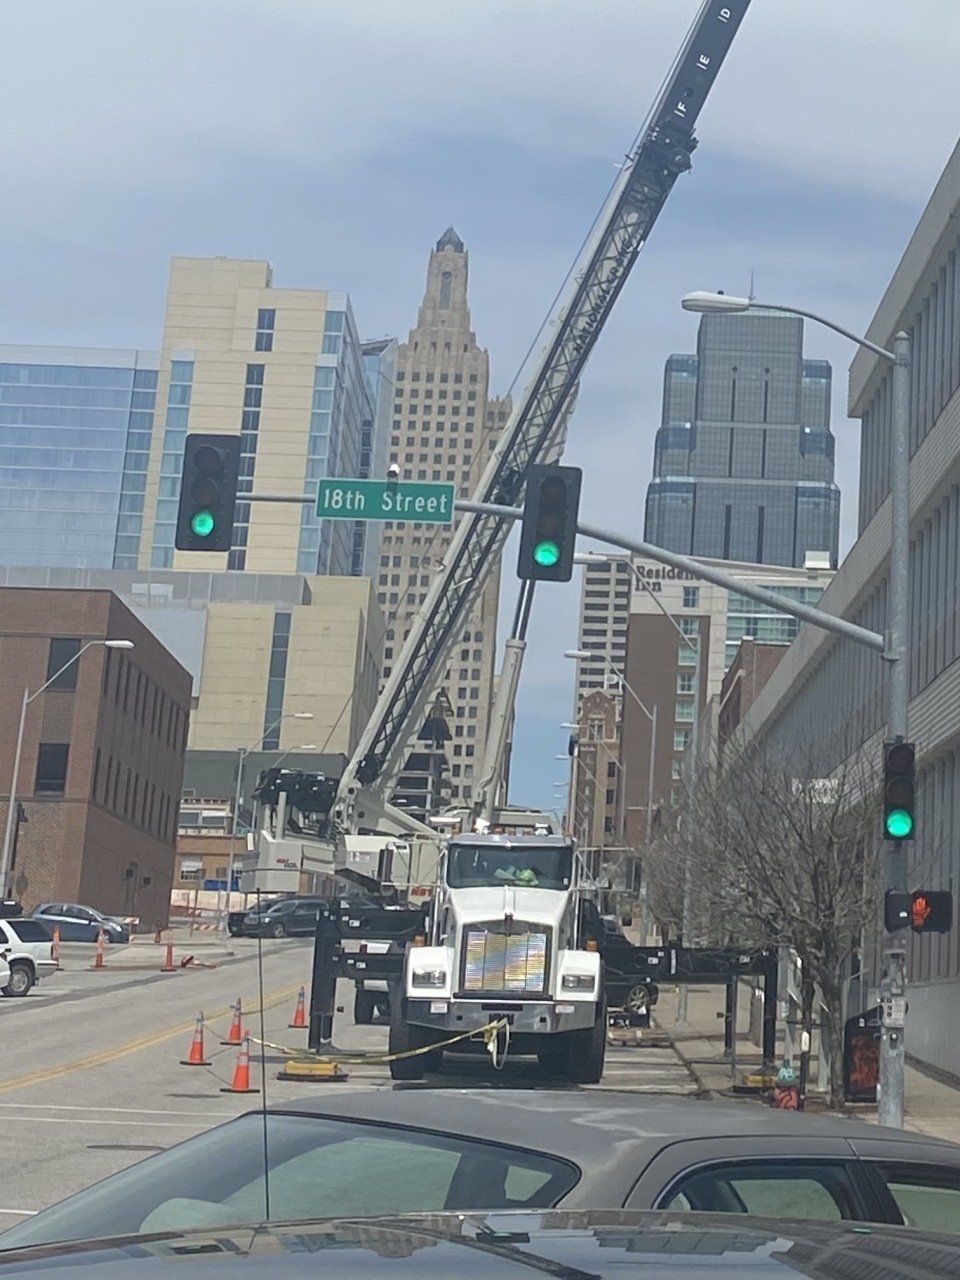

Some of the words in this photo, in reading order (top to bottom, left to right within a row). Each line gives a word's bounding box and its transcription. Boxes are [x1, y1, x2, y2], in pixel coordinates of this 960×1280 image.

[572, 285, 611, 355] NATIONAL
[324, 489, 365, 511] 18th
[381, 491, 447, 513] Street
[635, 579, 662, 592] Inn
